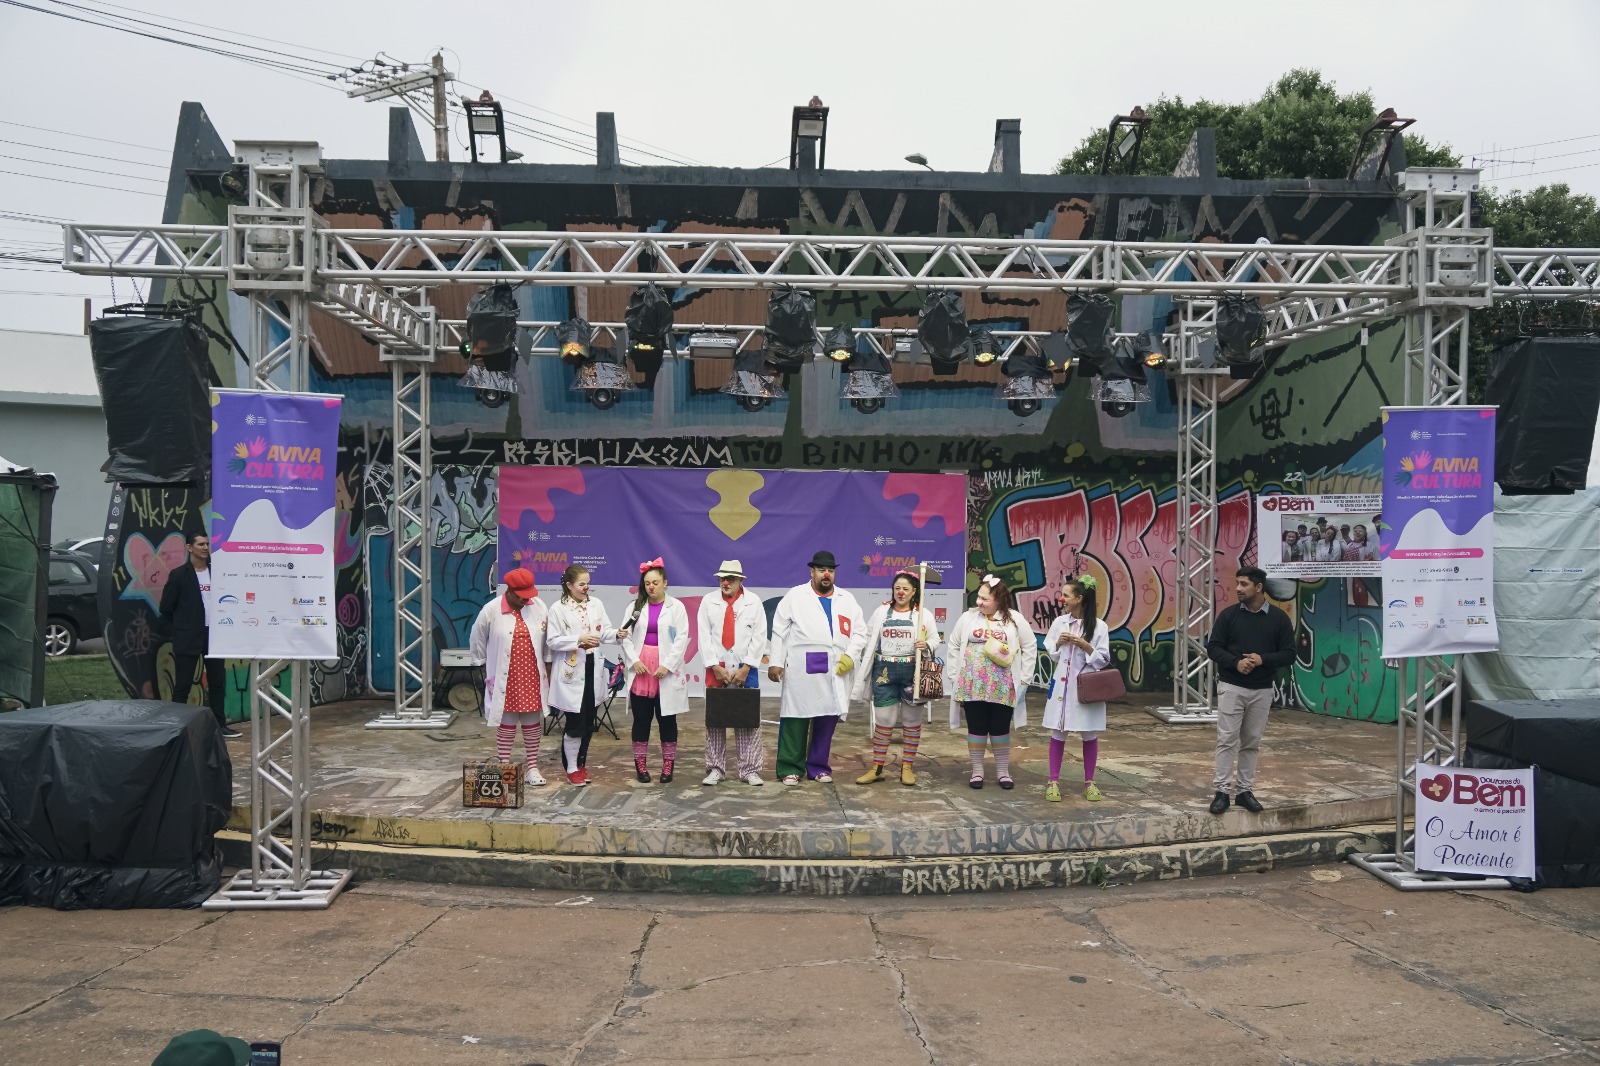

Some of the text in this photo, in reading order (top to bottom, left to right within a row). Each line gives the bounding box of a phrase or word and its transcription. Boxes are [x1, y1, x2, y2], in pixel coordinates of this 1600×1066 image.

[267, 445, 321, 463] AVIVA
[245, 461, 324, 480] CULTURA
[1432, 457, 1479, 472] AVIVA
[1411, 473, 1482, 489] CULTURA
[1278, 497, 1314, 511] Bem
[533, 552, 567, 562] AVIVA
[883, 556, 916, 567] AVIVA
[890, 628, 912, 639] Bem
[1480, 776, 1521, 785] Doutores do
[481, 782, 502, 796] 66
[1453, 774, 1526, 807] Bem
[1425, 816, 1522, 843] O Amor é
[1434, 844, 1514, 869] Paciente
